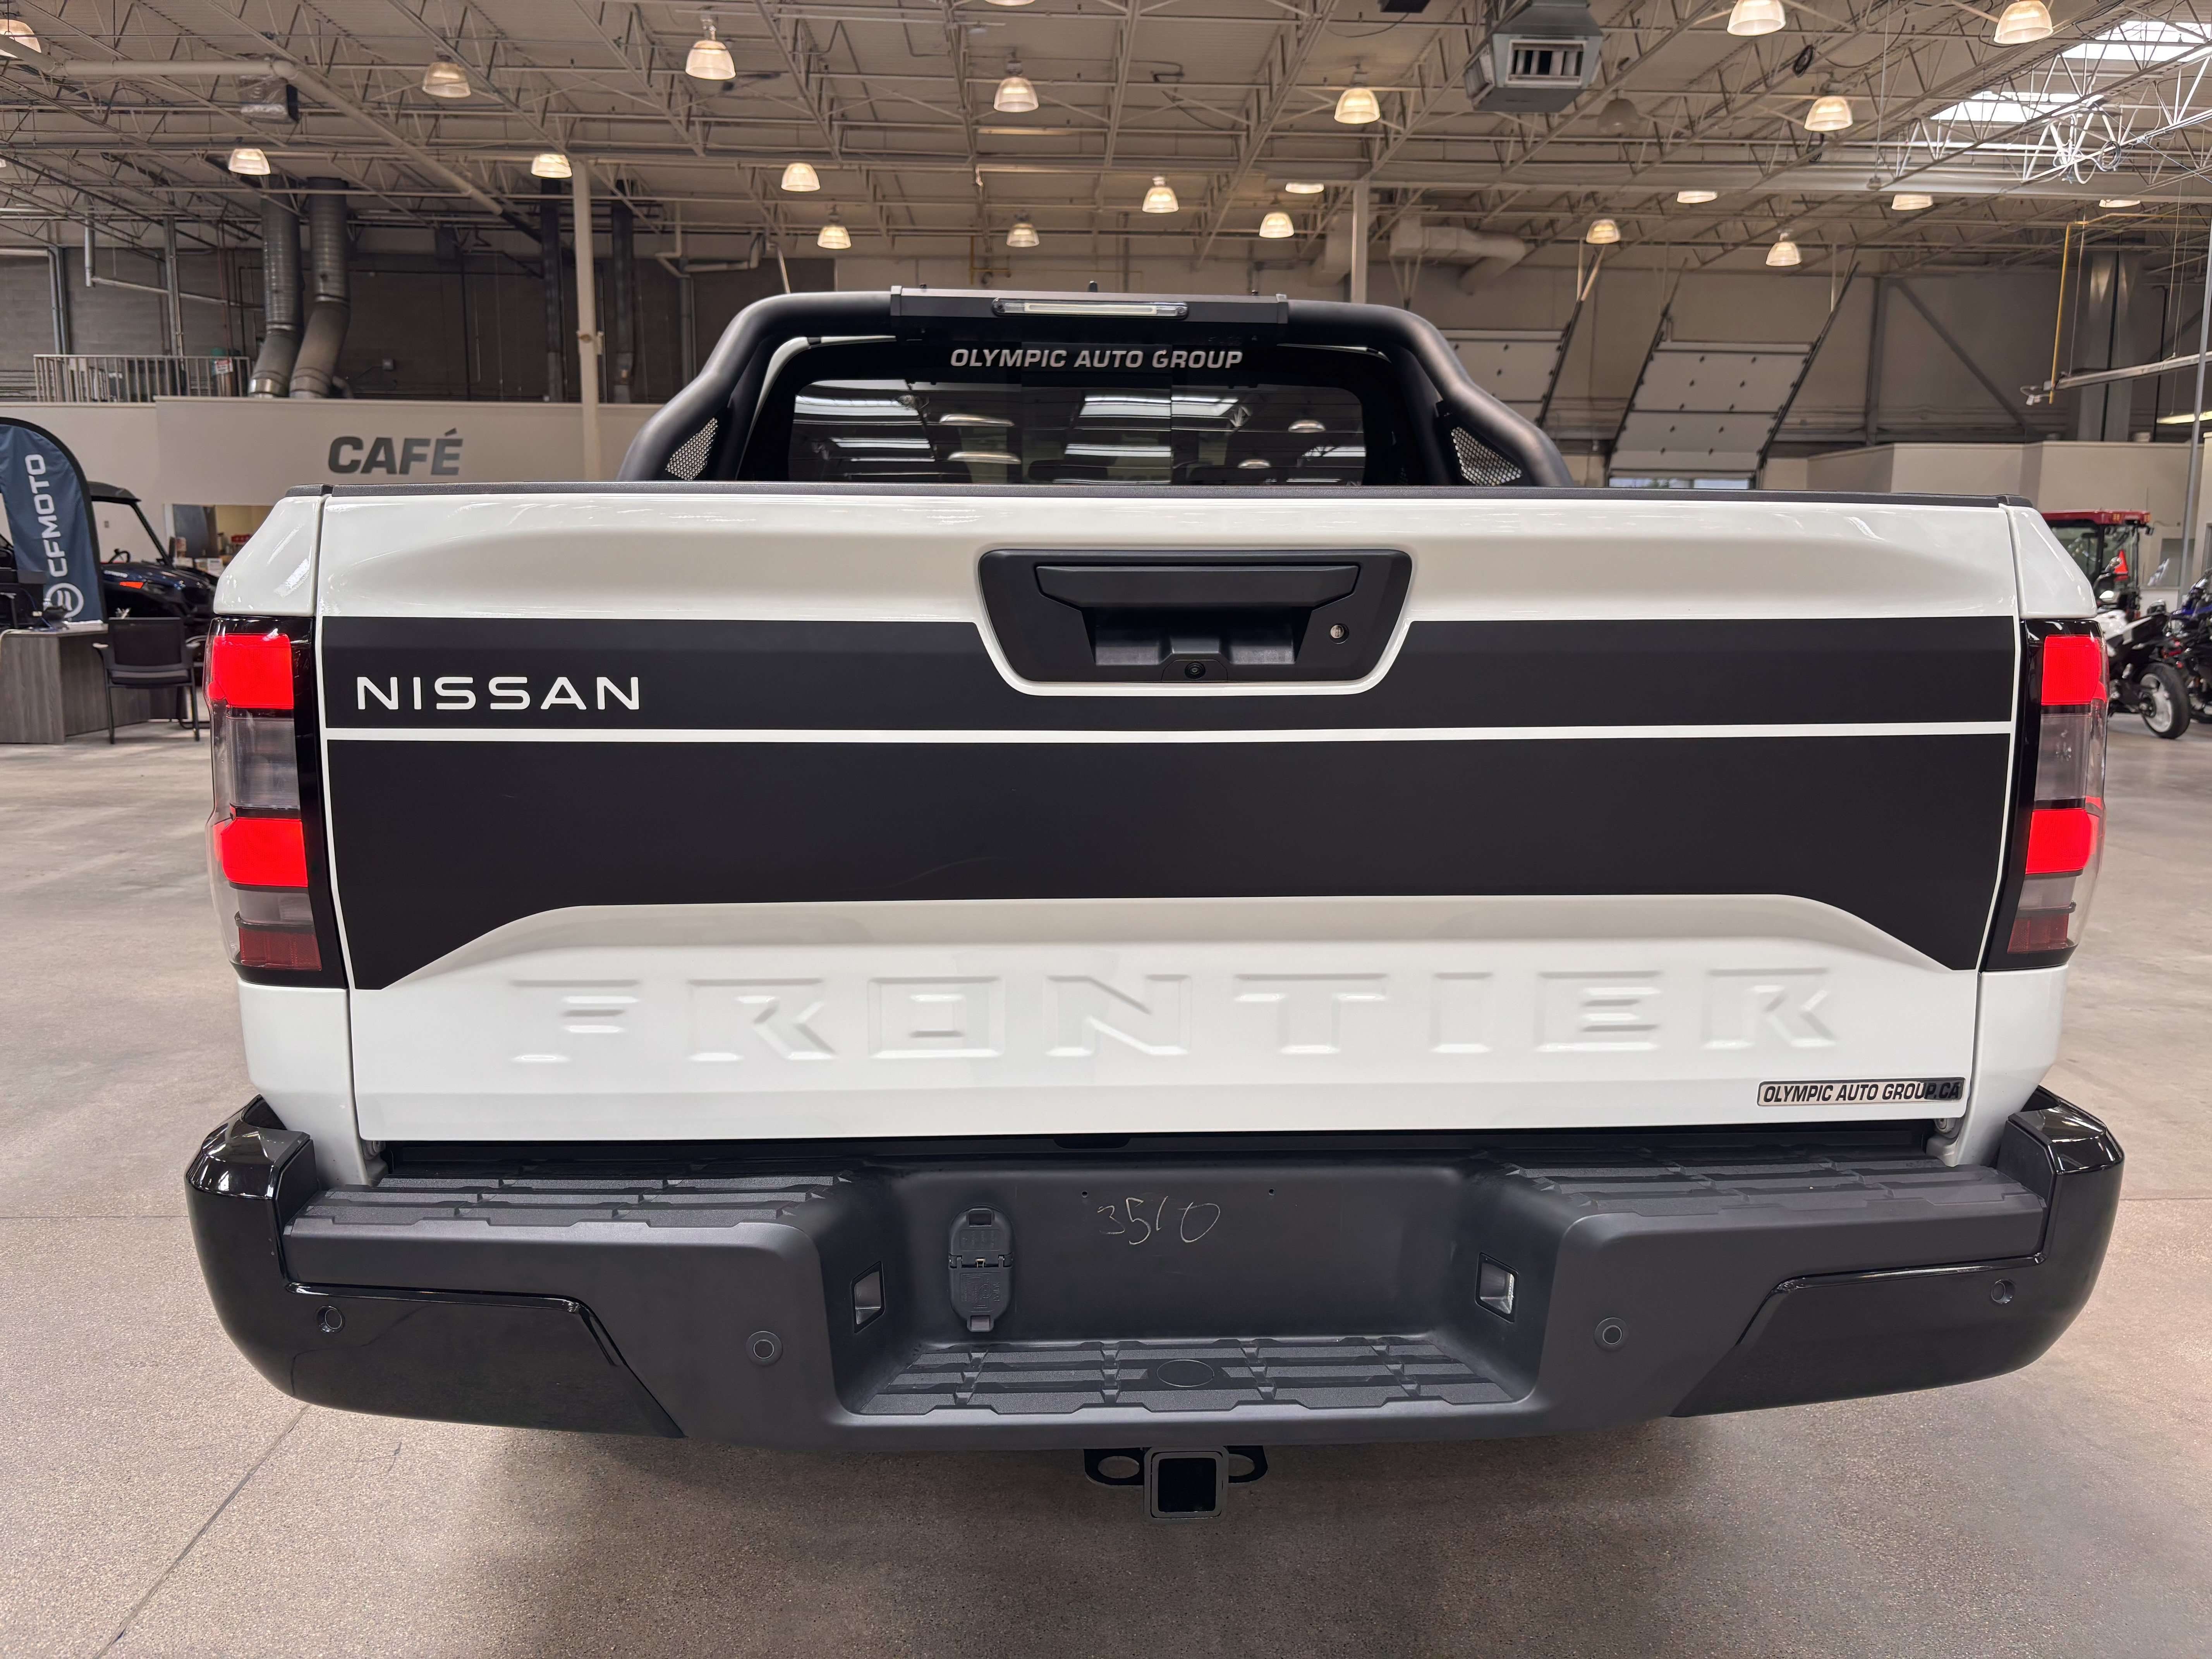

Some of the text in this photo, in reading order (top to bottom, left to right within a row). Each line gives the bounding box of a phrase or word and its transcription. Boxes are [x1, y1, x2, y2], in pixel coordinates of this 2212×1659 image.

[950, 349, 1243, 369] OLYMPIC AUTO GROUP
[328, 428, 463, 476] CAFÉ
[25, 454, 68, 577] CFMOTO
[357, 677, 639, 710] NISSAN
[508, 967, 1839, 1062] FRONTIER
[1763, 1082, 1960, 1103] OLYMPIC AUTO GROUP.CA
[1097, 1196, 1221, 1245] 3510
